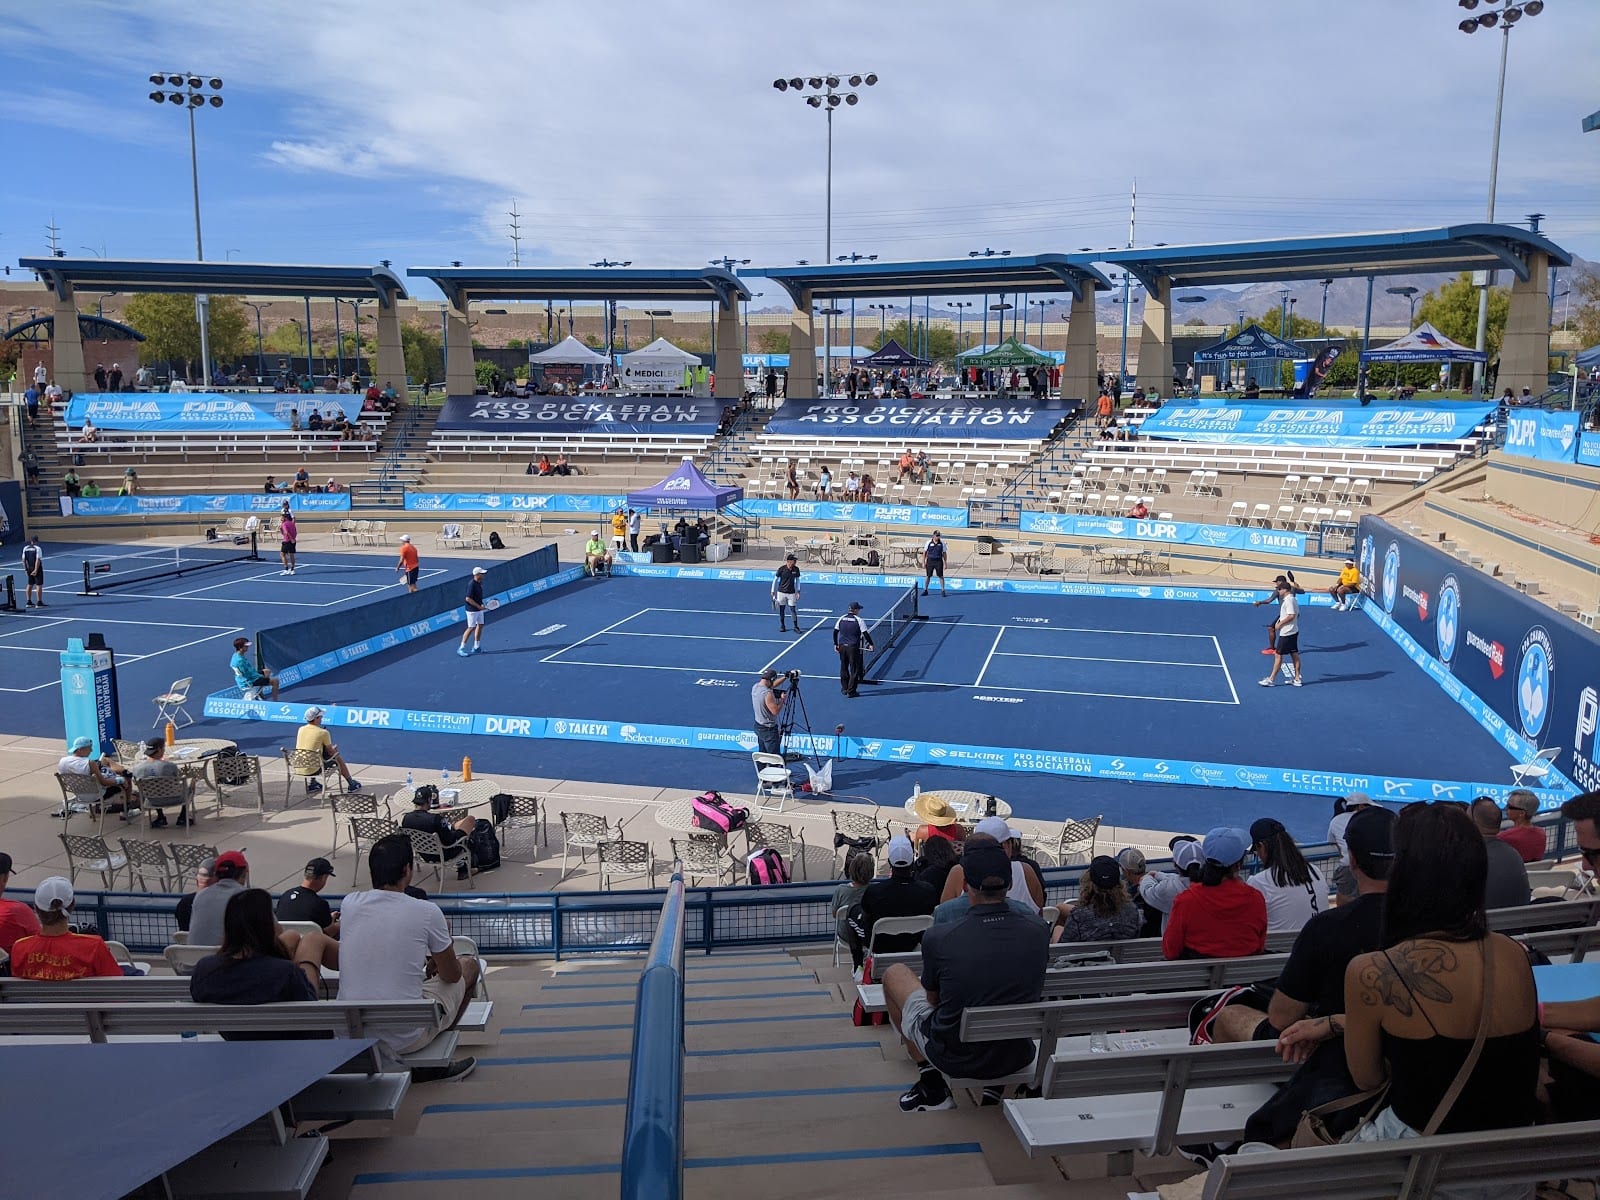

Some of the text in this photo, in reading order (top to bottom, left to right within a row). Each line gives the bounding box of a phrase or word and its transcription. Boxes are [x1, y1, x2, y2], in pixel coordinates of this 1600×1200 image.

[1214, 351, 1227, 360] fun
[1250, 349, 1266, 358] good
[743, 356, 767, 366] DUPR
[635, 370, 685, 378] MEDICILEAF
[475, 402, 700, 413] PRO PICKLEBALL
[871, 407, 1035, 415] PICKLEBALL
[469, 410, 698, 422] ASSOCIATION
[799, 414, 1035, 425] ASSOCIATION
[1158, 420, 1237, 430] ASSOCIATION
[1360, 426, 1454, 436] ASSOCIATION
[1508, 419, 1537, 447] DUPR
[512, 496, 548, 508] DUPR
[778, 503, 815, 513] ACRYTECH
[1136, 523, 1177, 538] DUPR
[1264, 535, 1298, 547] TAKEYA
[677, 567, 704, 577] Franklin
[976, 581, 1004, 590] DUPR
[410, 621, 431, 637] DUPR
[1466, 630, 1504, 666] guaranteedRate
[96, 685, 102, 696] AN
[101, 674, 112, 718] HYDRATION
[207, 707, 266, 717] ASSOCIATION
[347, 710, 390, 726] DUPR
[407, 713, 470, 725] ELECTRUM
[98, 723, 106, 743] GAME
[485, 719, 531, 735] DUPR
[569, 722, 608, 735] TAKEYA
[625, 732, 690, 745] Select MEDICAL
[949, 751, 1004, 760] SELKIRK
[1036, 755, 1092, 764] PICKLEBALL
[1573, 751, 1588, 769] PRO
[1014, 760, 1092, 773] ASSOCIATION
[1282, 772, 1368, 788] ELECTRUM
[1476, 787, 1498, 796] PRO
